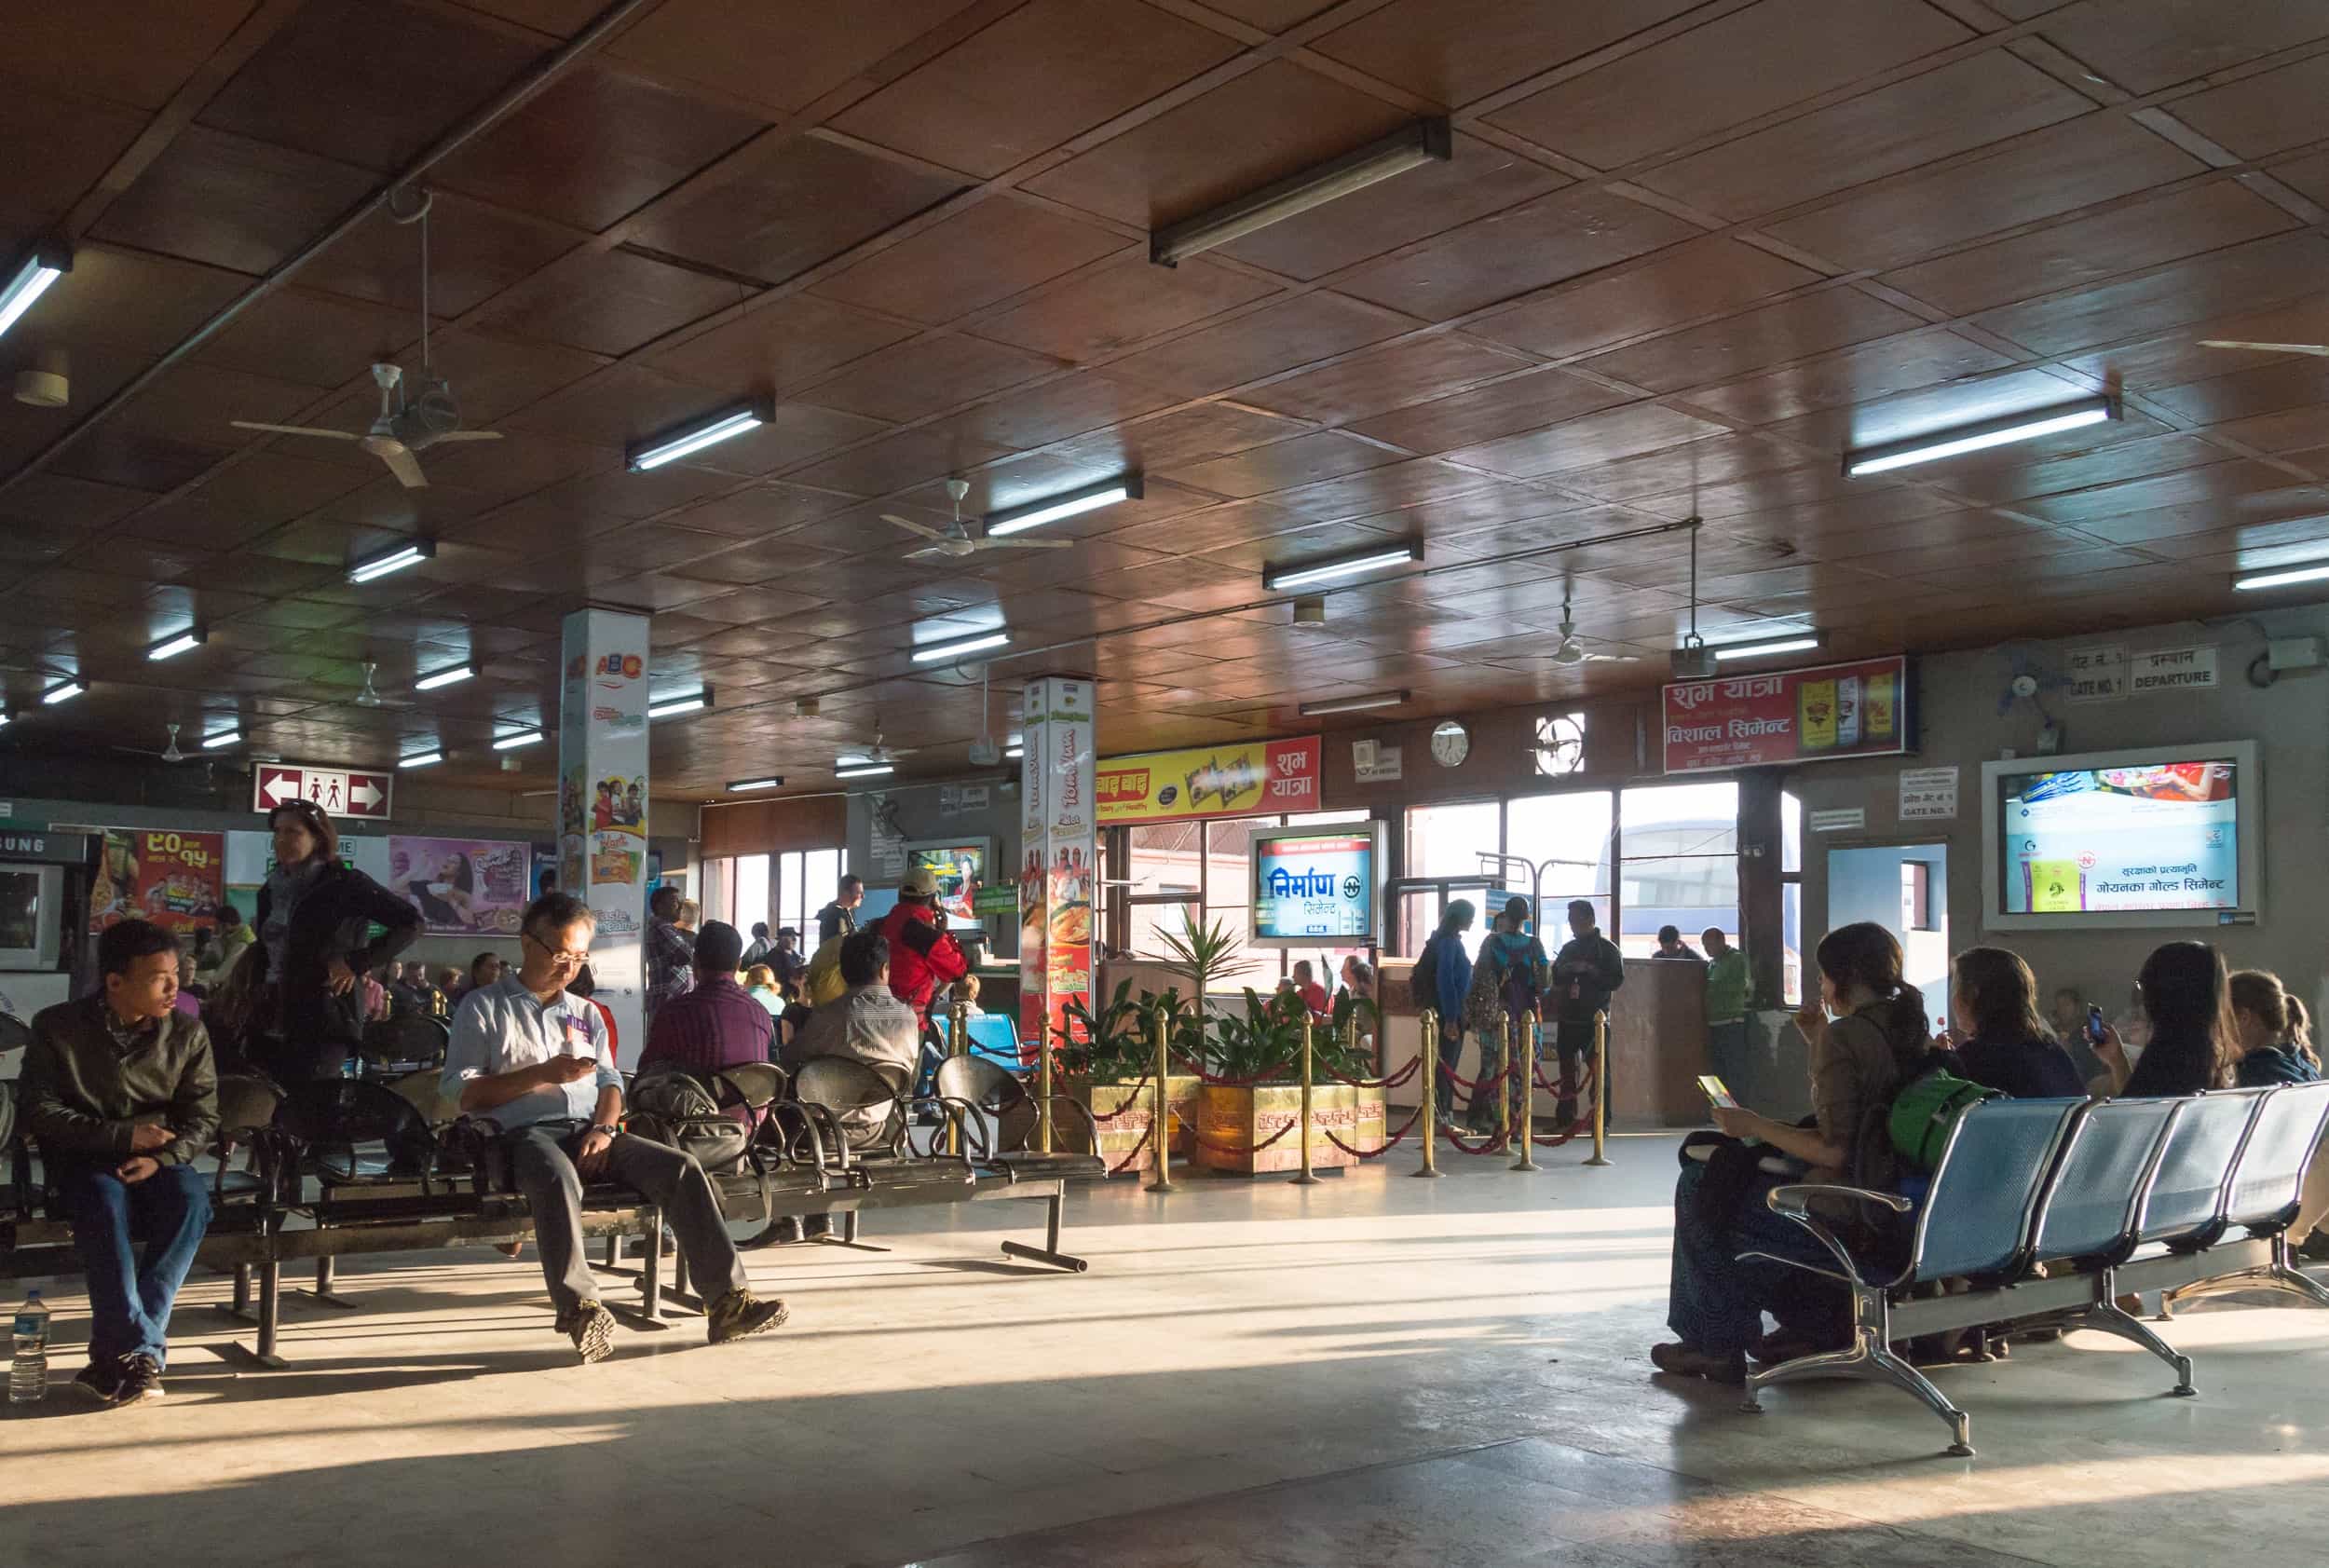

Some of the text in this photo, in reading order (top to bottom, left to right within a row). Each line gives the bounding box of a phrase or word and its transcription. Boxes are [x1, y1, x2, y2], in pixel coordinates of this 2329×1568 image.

[595, 653, 643, 679] ABC
[1672, 675, 1786, 709] शुभ यात्रा
[2134, 671, 2212, 689] DEPARTURE
[1667, 716, 1790, 744] विशाल सिमेन्ट
[1276, 751, 1307, 775] शुभ
[1272, 775, 1313, 798] यात्रा
[1903, 807, 1927, 816] GATE
[1267, 866, 1337, 899] निर्माण
[2096, 878, 2225, 894] गोयनका गोल्ड सिमेन्ट
